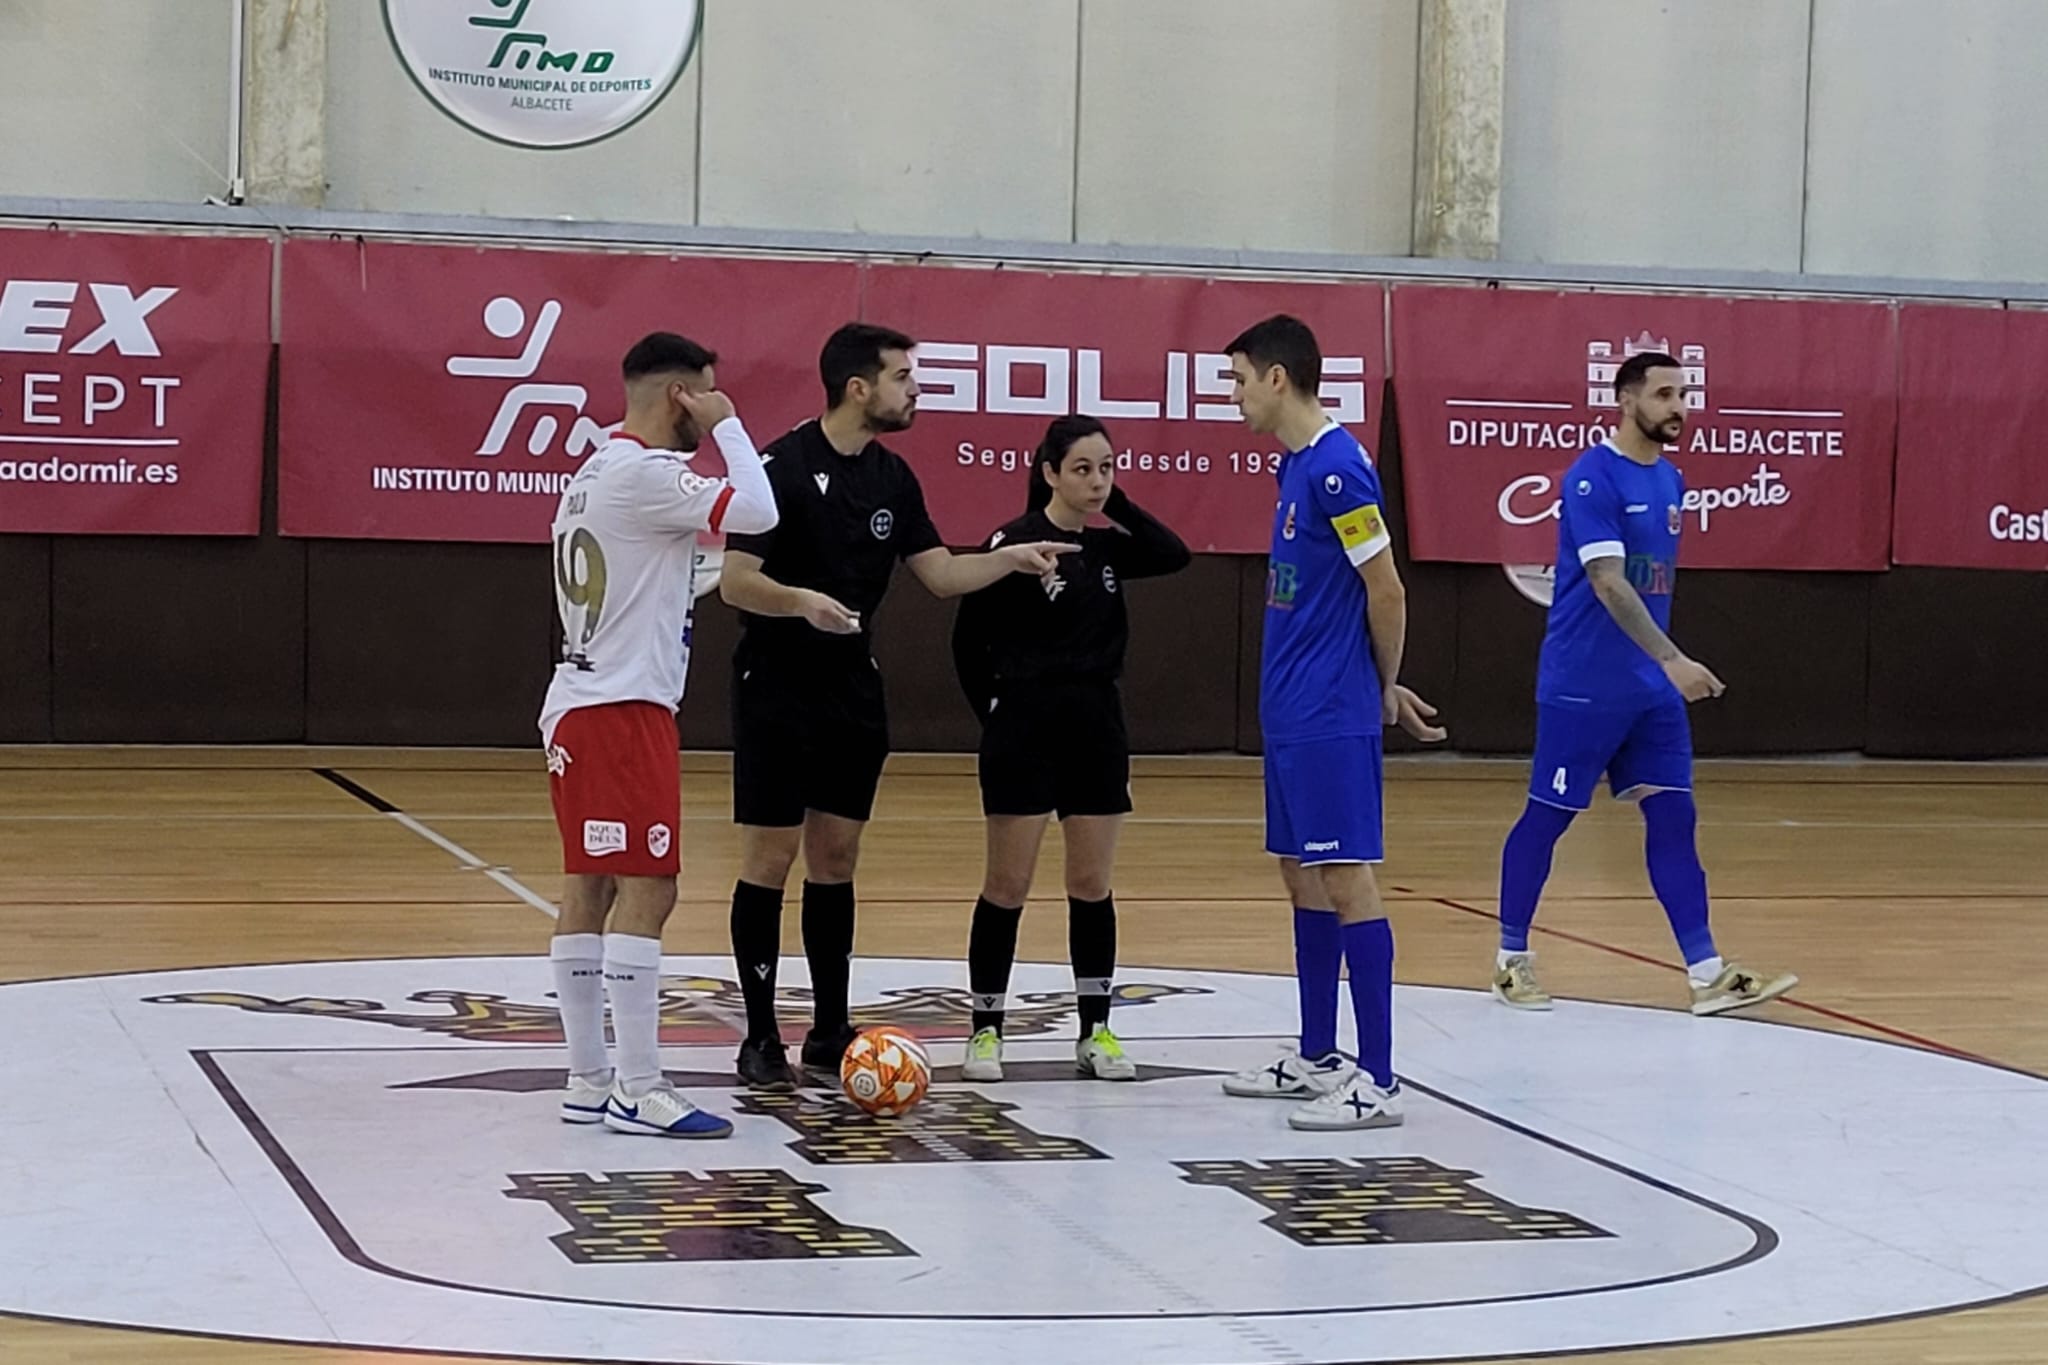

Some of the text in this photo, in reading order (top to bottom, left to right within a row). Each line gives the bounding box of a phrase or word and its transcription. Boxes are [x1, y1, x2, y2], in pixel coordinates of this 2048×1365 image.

[428, 67, 652, 93] INSTITUTO MUNICIPAL DE DEPORTES
[511, 96, 573, 112] ALBACETE
[0, 373, 181, 427] EPT
[1690, 428, 1843, 456] ALBACETE
[0, 456, 178, 484] aadormir.es
[957, 441, 1283, 474] Segu desde 193
[373, 467, 574, 494] INSTITUTO MUNIC
[1678, 462, 1790, 532] eporte
[1552, 767, 1567, 795] 4
